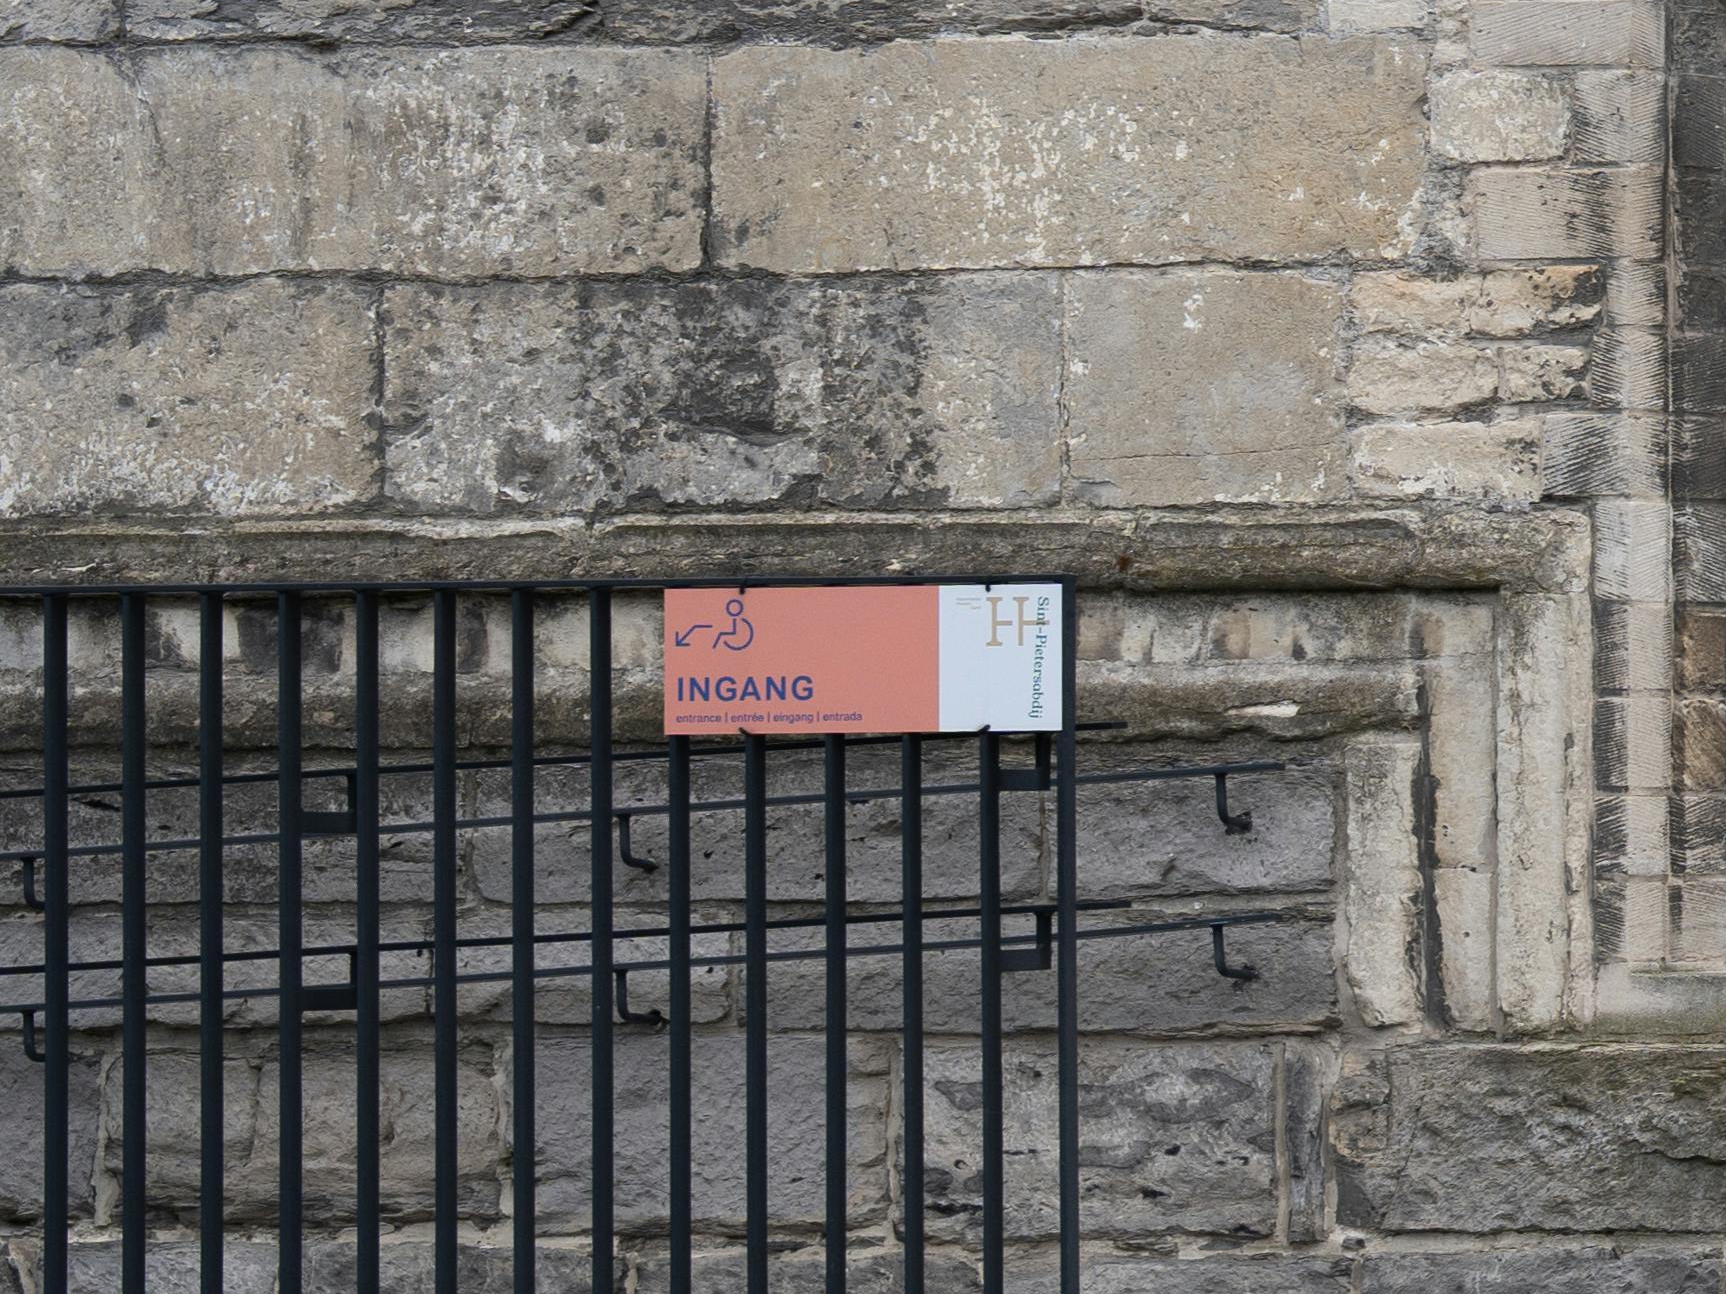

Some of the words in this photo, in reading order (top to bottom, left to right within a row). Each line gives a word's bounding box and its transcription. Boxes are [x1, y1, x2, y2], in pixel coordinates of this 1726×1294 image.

[1028, 596, 1050, 719] Sint-Pietersabdij
[677, 675, 815, 702] INGANG
[676, 714, 722, 723] entrance
[730, 712, 765, 723] entrée
[773, 712, 814, 724] eingang
[822, 711, 863, 722] entrada
